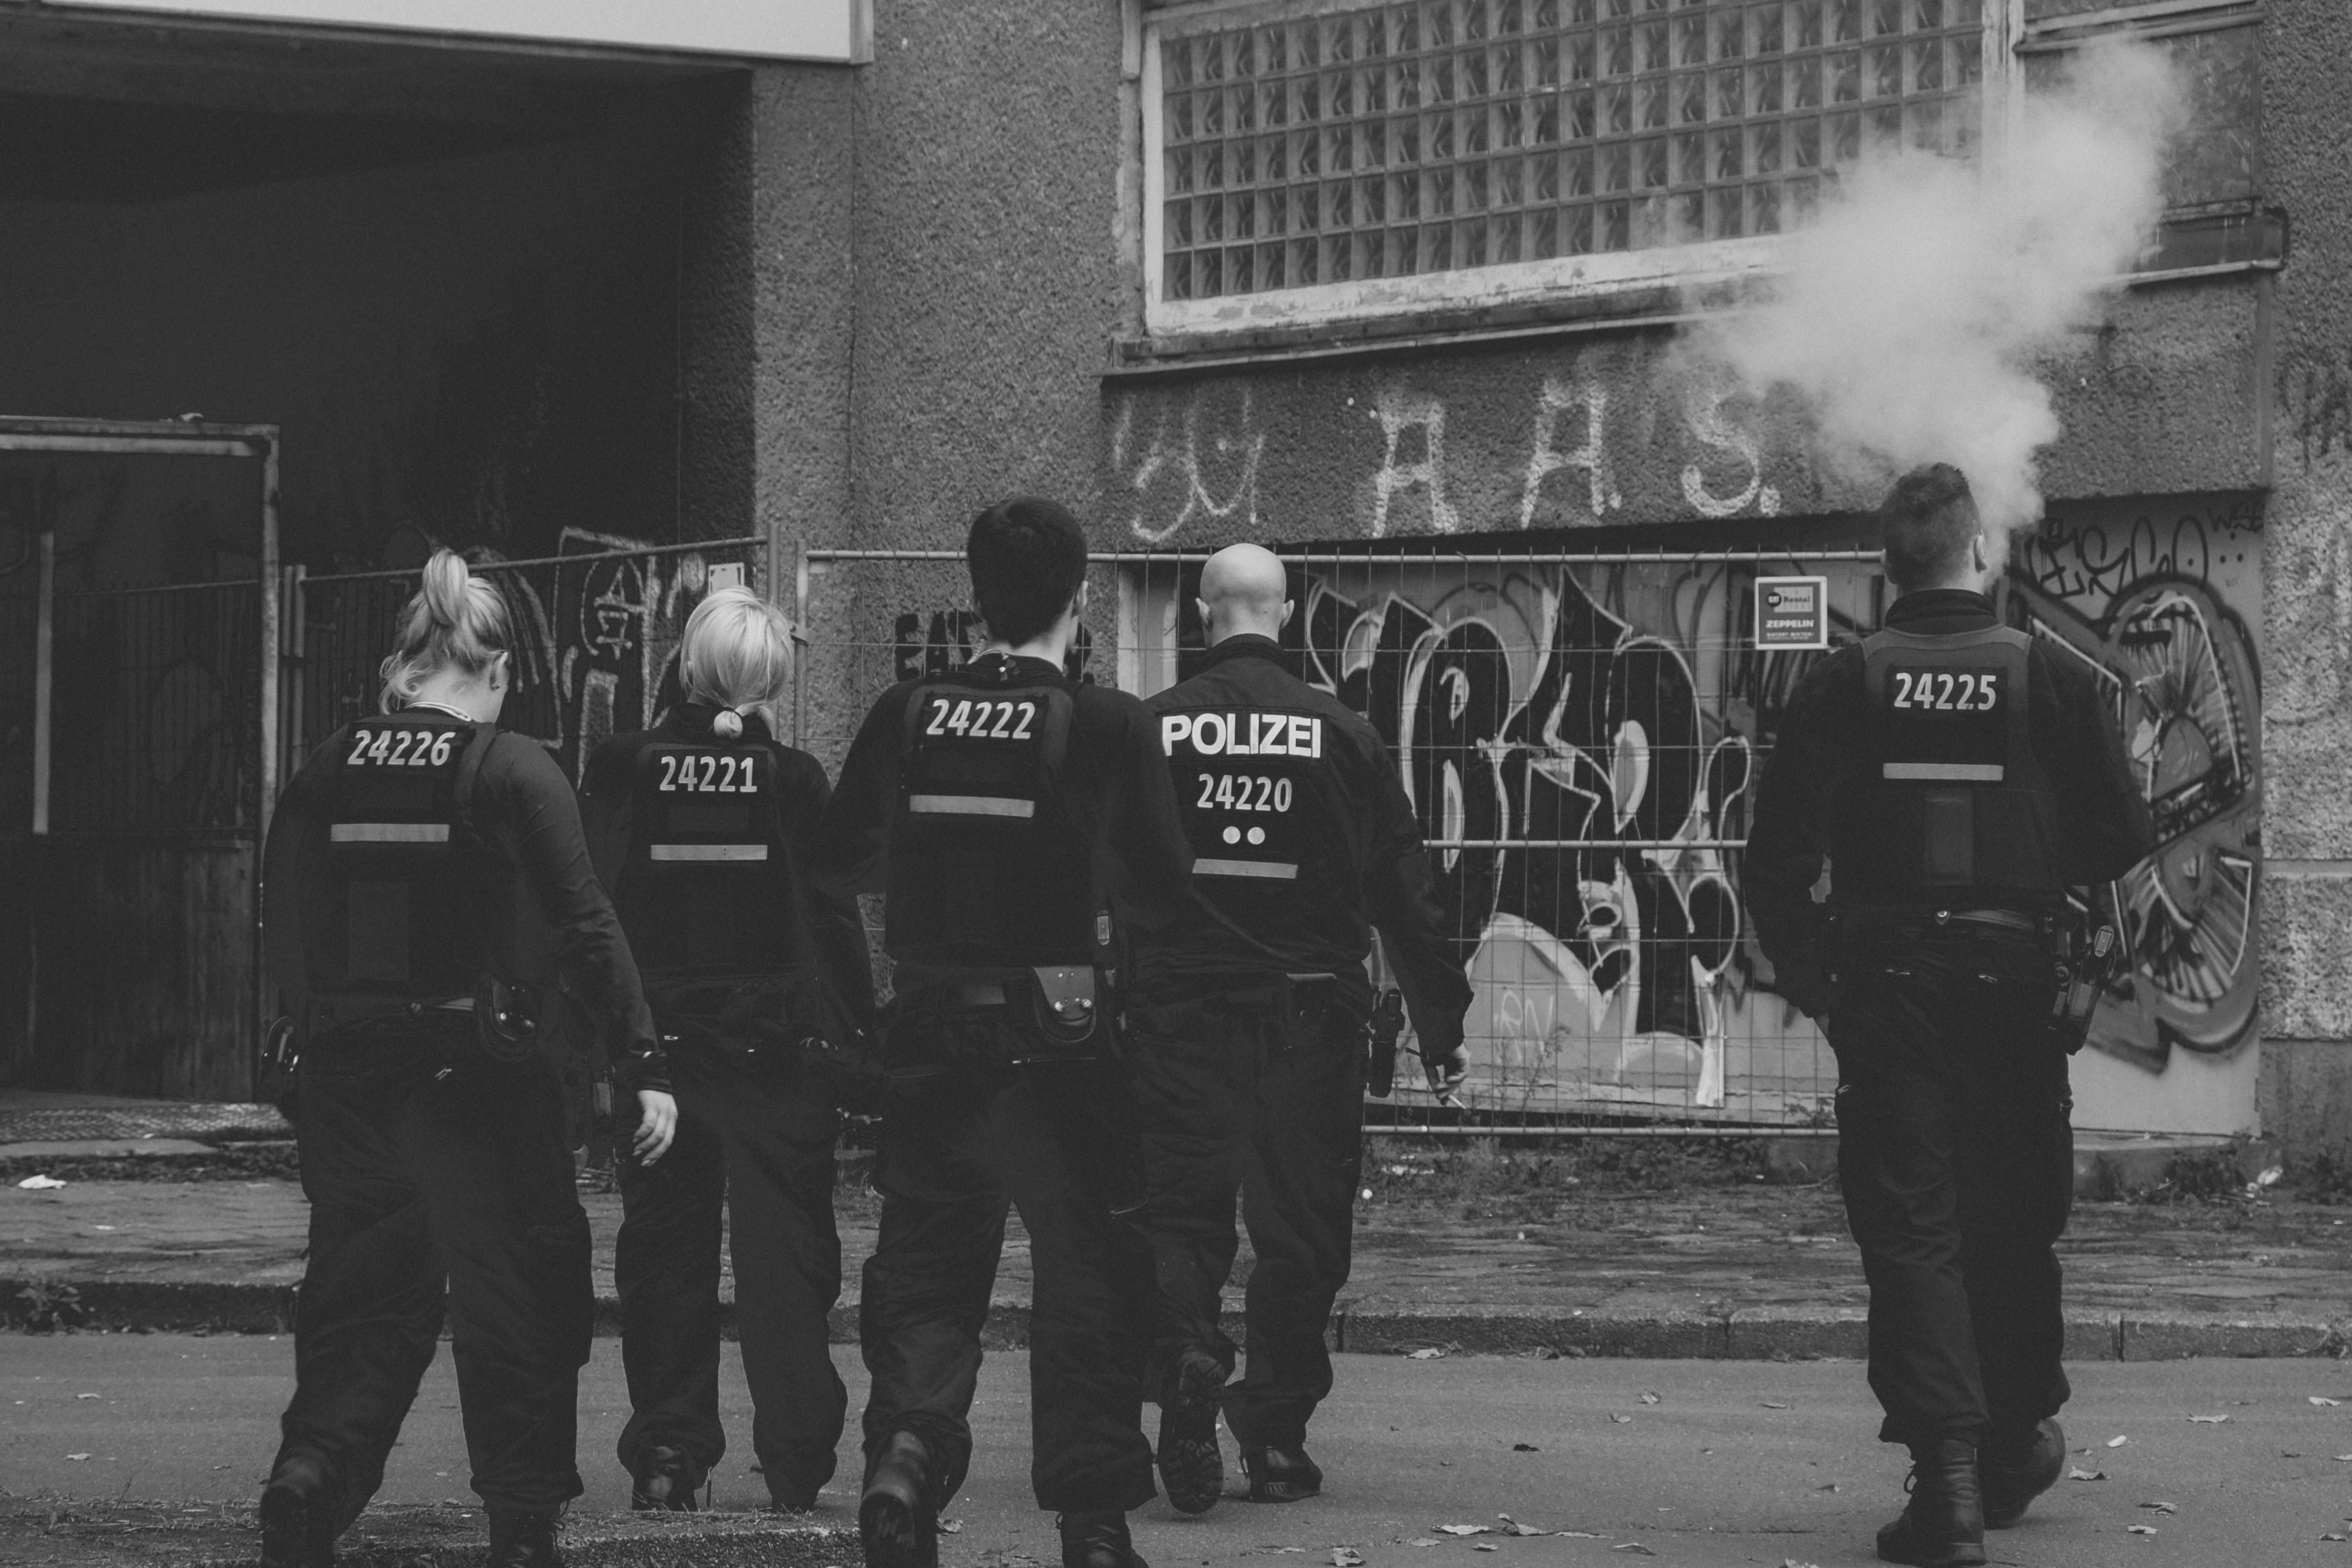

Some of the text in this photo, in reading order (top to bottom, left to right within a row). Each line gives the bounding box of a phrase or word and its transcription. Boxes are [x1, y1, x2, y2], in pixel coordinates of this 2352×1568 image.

[1766, 619, 1814, 629] ZEPPELIN
[1894, 672, 1996, 711] 24225
[926, 699, 1035, 739] 24222
[1162, 713, 1321, 758] POLIZEI
[347, 730, 456, 766] 24226
[659, 756, 757, 792] 24221
[1197, 774, 1292, 812] 24220
